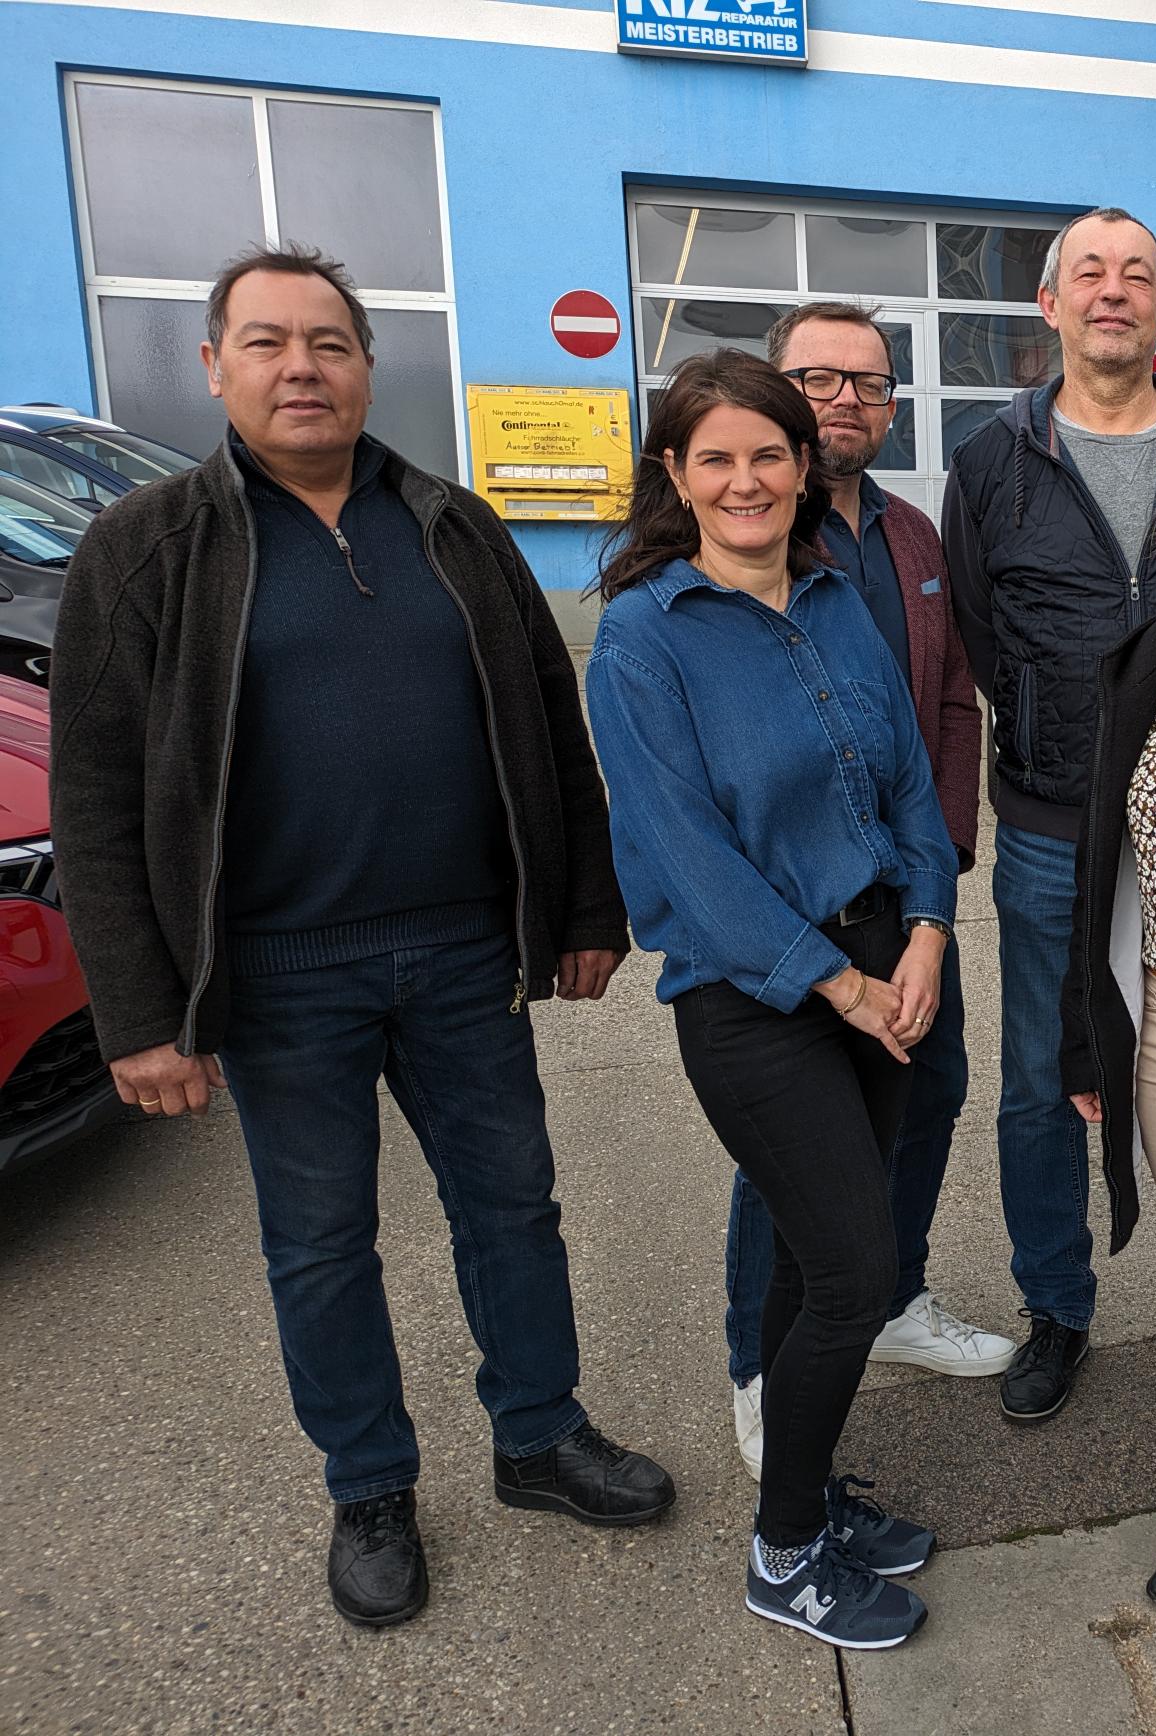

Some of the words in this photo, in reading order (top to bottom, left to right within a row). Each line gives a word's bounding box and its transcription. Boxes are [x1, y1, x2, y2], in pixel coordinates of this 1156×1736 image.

[722, 12, 798, 29] REPARATUR
[626, 21, 798, 52] MEISTERBETRIEB
[505, 409, 523, 417] mehr
